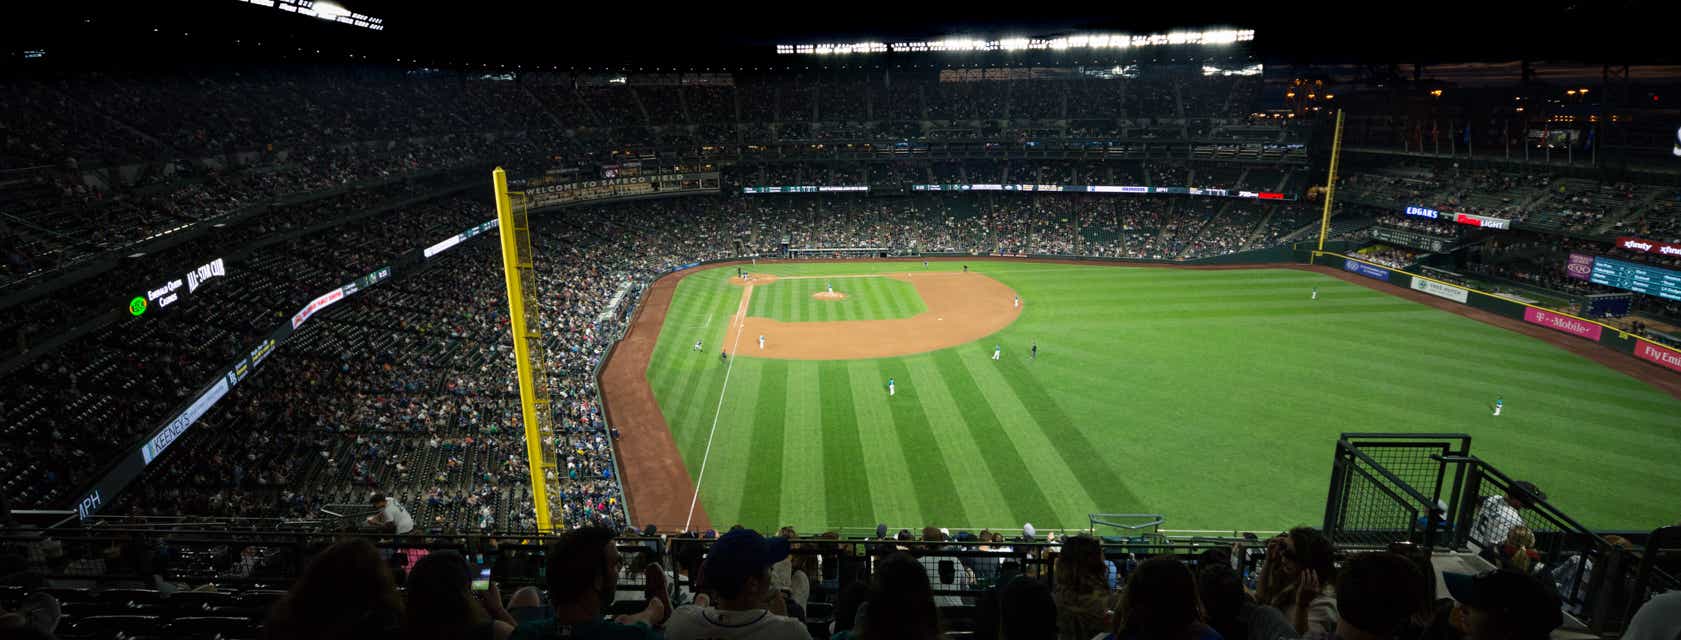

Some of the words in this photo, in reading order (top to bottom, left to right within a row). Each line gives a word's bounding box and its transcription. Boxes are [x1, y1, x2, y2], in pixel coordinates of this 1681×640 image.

[526, 183, 578, 194] WELCOME
[583, 180, 597, 188] TO
[601, 176, 646, 186] SAFECO
[651, 174, 684, 182] FIELD
[1481, 218, 1504, 229] LIGHT
[1624, 240, 1653, 252] xfinity
[211, 258, 225, 276] CLUB
[1645, 346, 1662, 360] Fly
